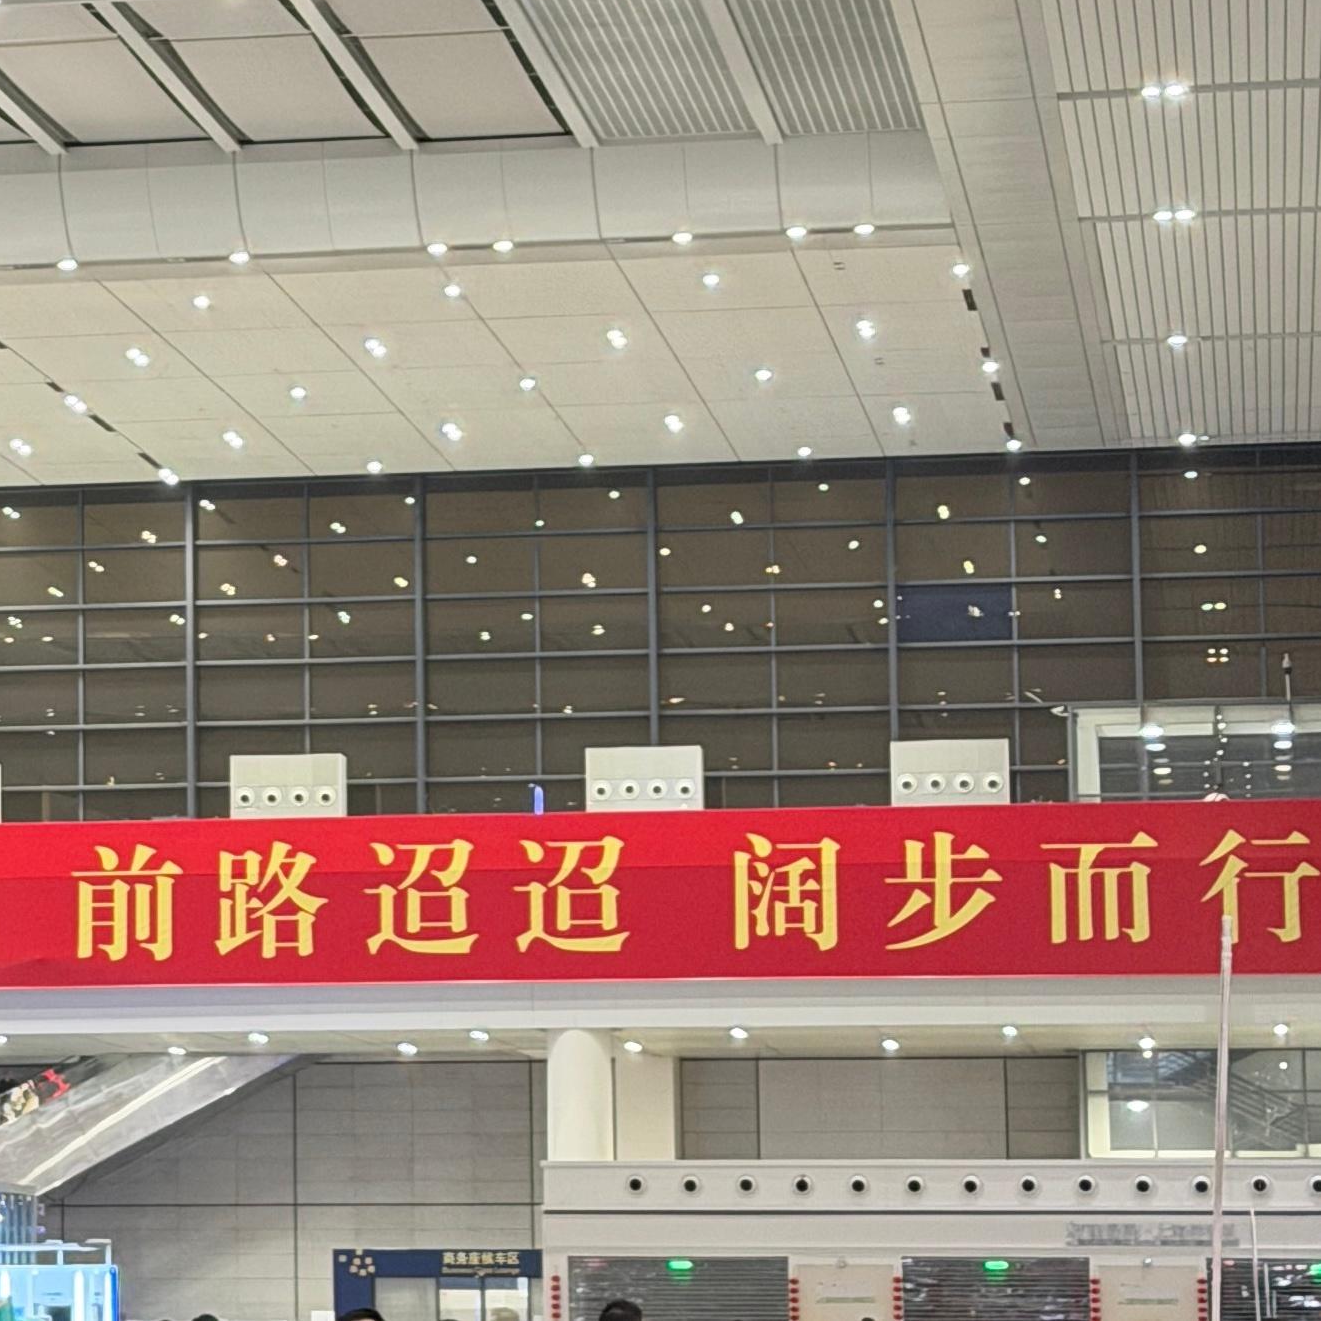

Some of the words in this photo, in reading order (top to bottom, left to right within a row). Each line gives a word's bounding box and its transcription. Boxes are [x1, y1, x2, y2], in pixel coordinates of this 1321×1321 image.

[72, 836, 630, 961] 前路迢迢
[733, 830, 1319, 951] 阔步而行
